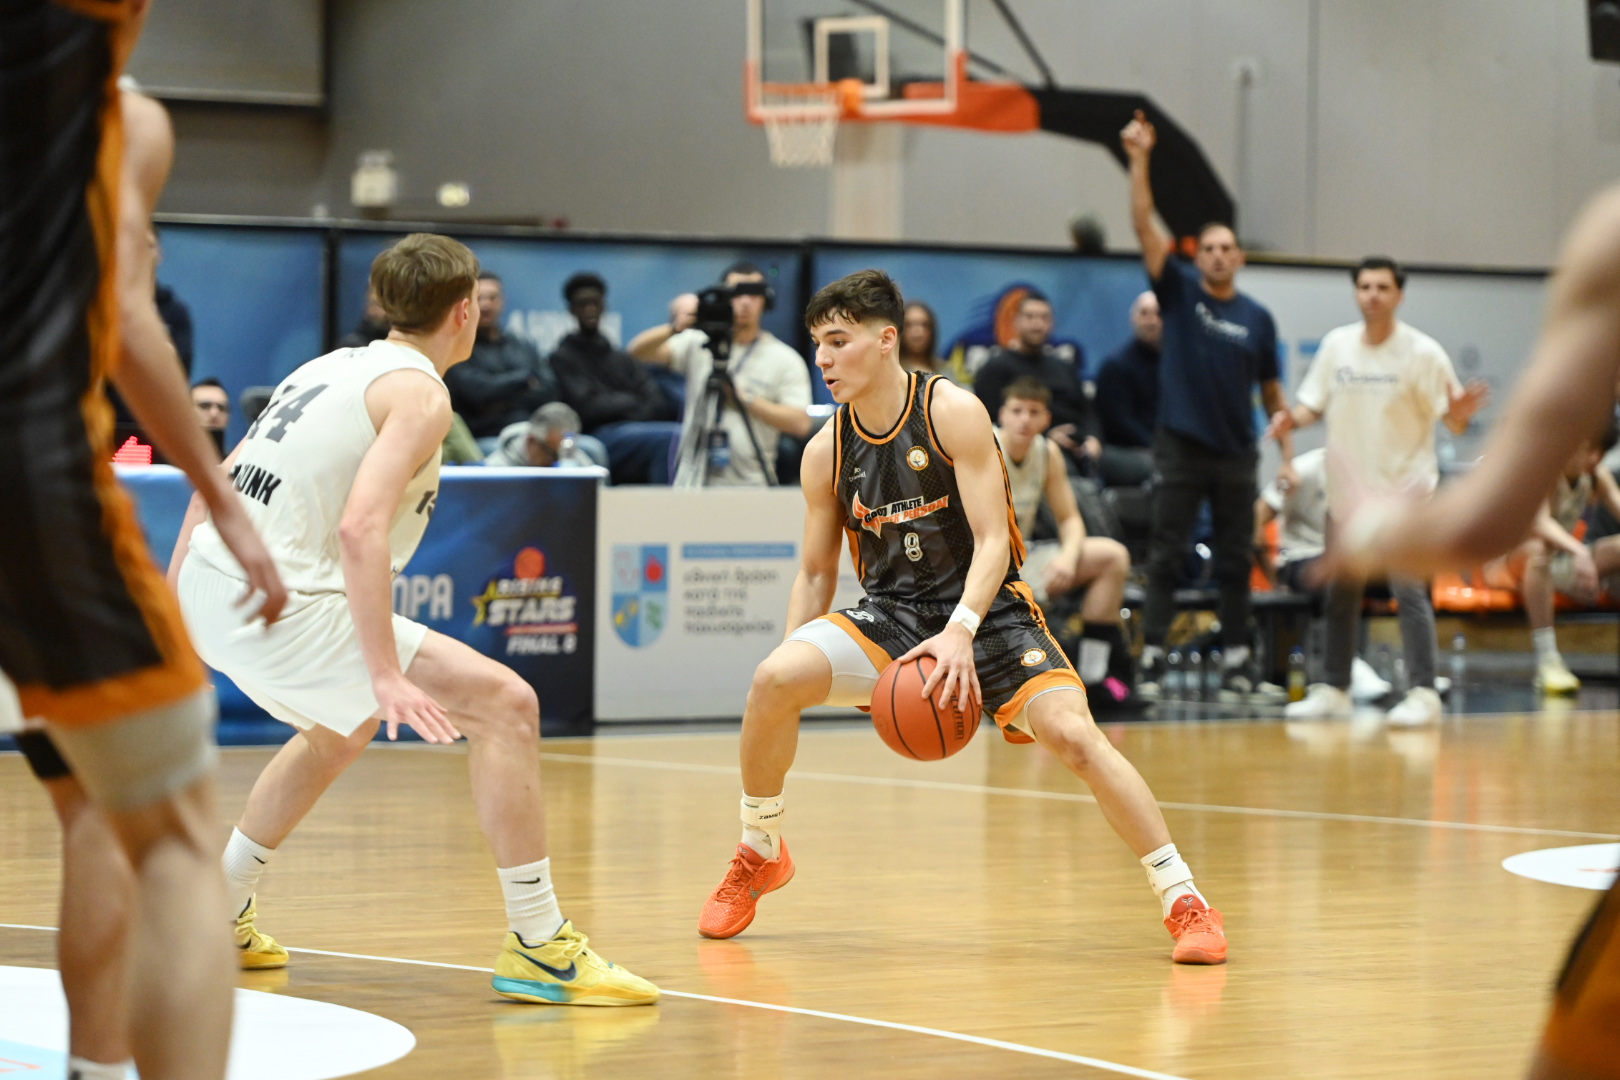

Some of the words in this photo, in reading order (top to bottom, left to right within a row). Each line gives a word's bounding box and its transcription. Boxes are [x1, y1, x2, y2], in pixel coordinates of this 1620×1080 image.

[891, 498, 922, 515] ATHLETE
[903, 497, 947, 520] PERSON
[904, 532, 923, 561] 8
[487, 596, 577, 626] STARS
[506, 634, 560, 656] FINAL
